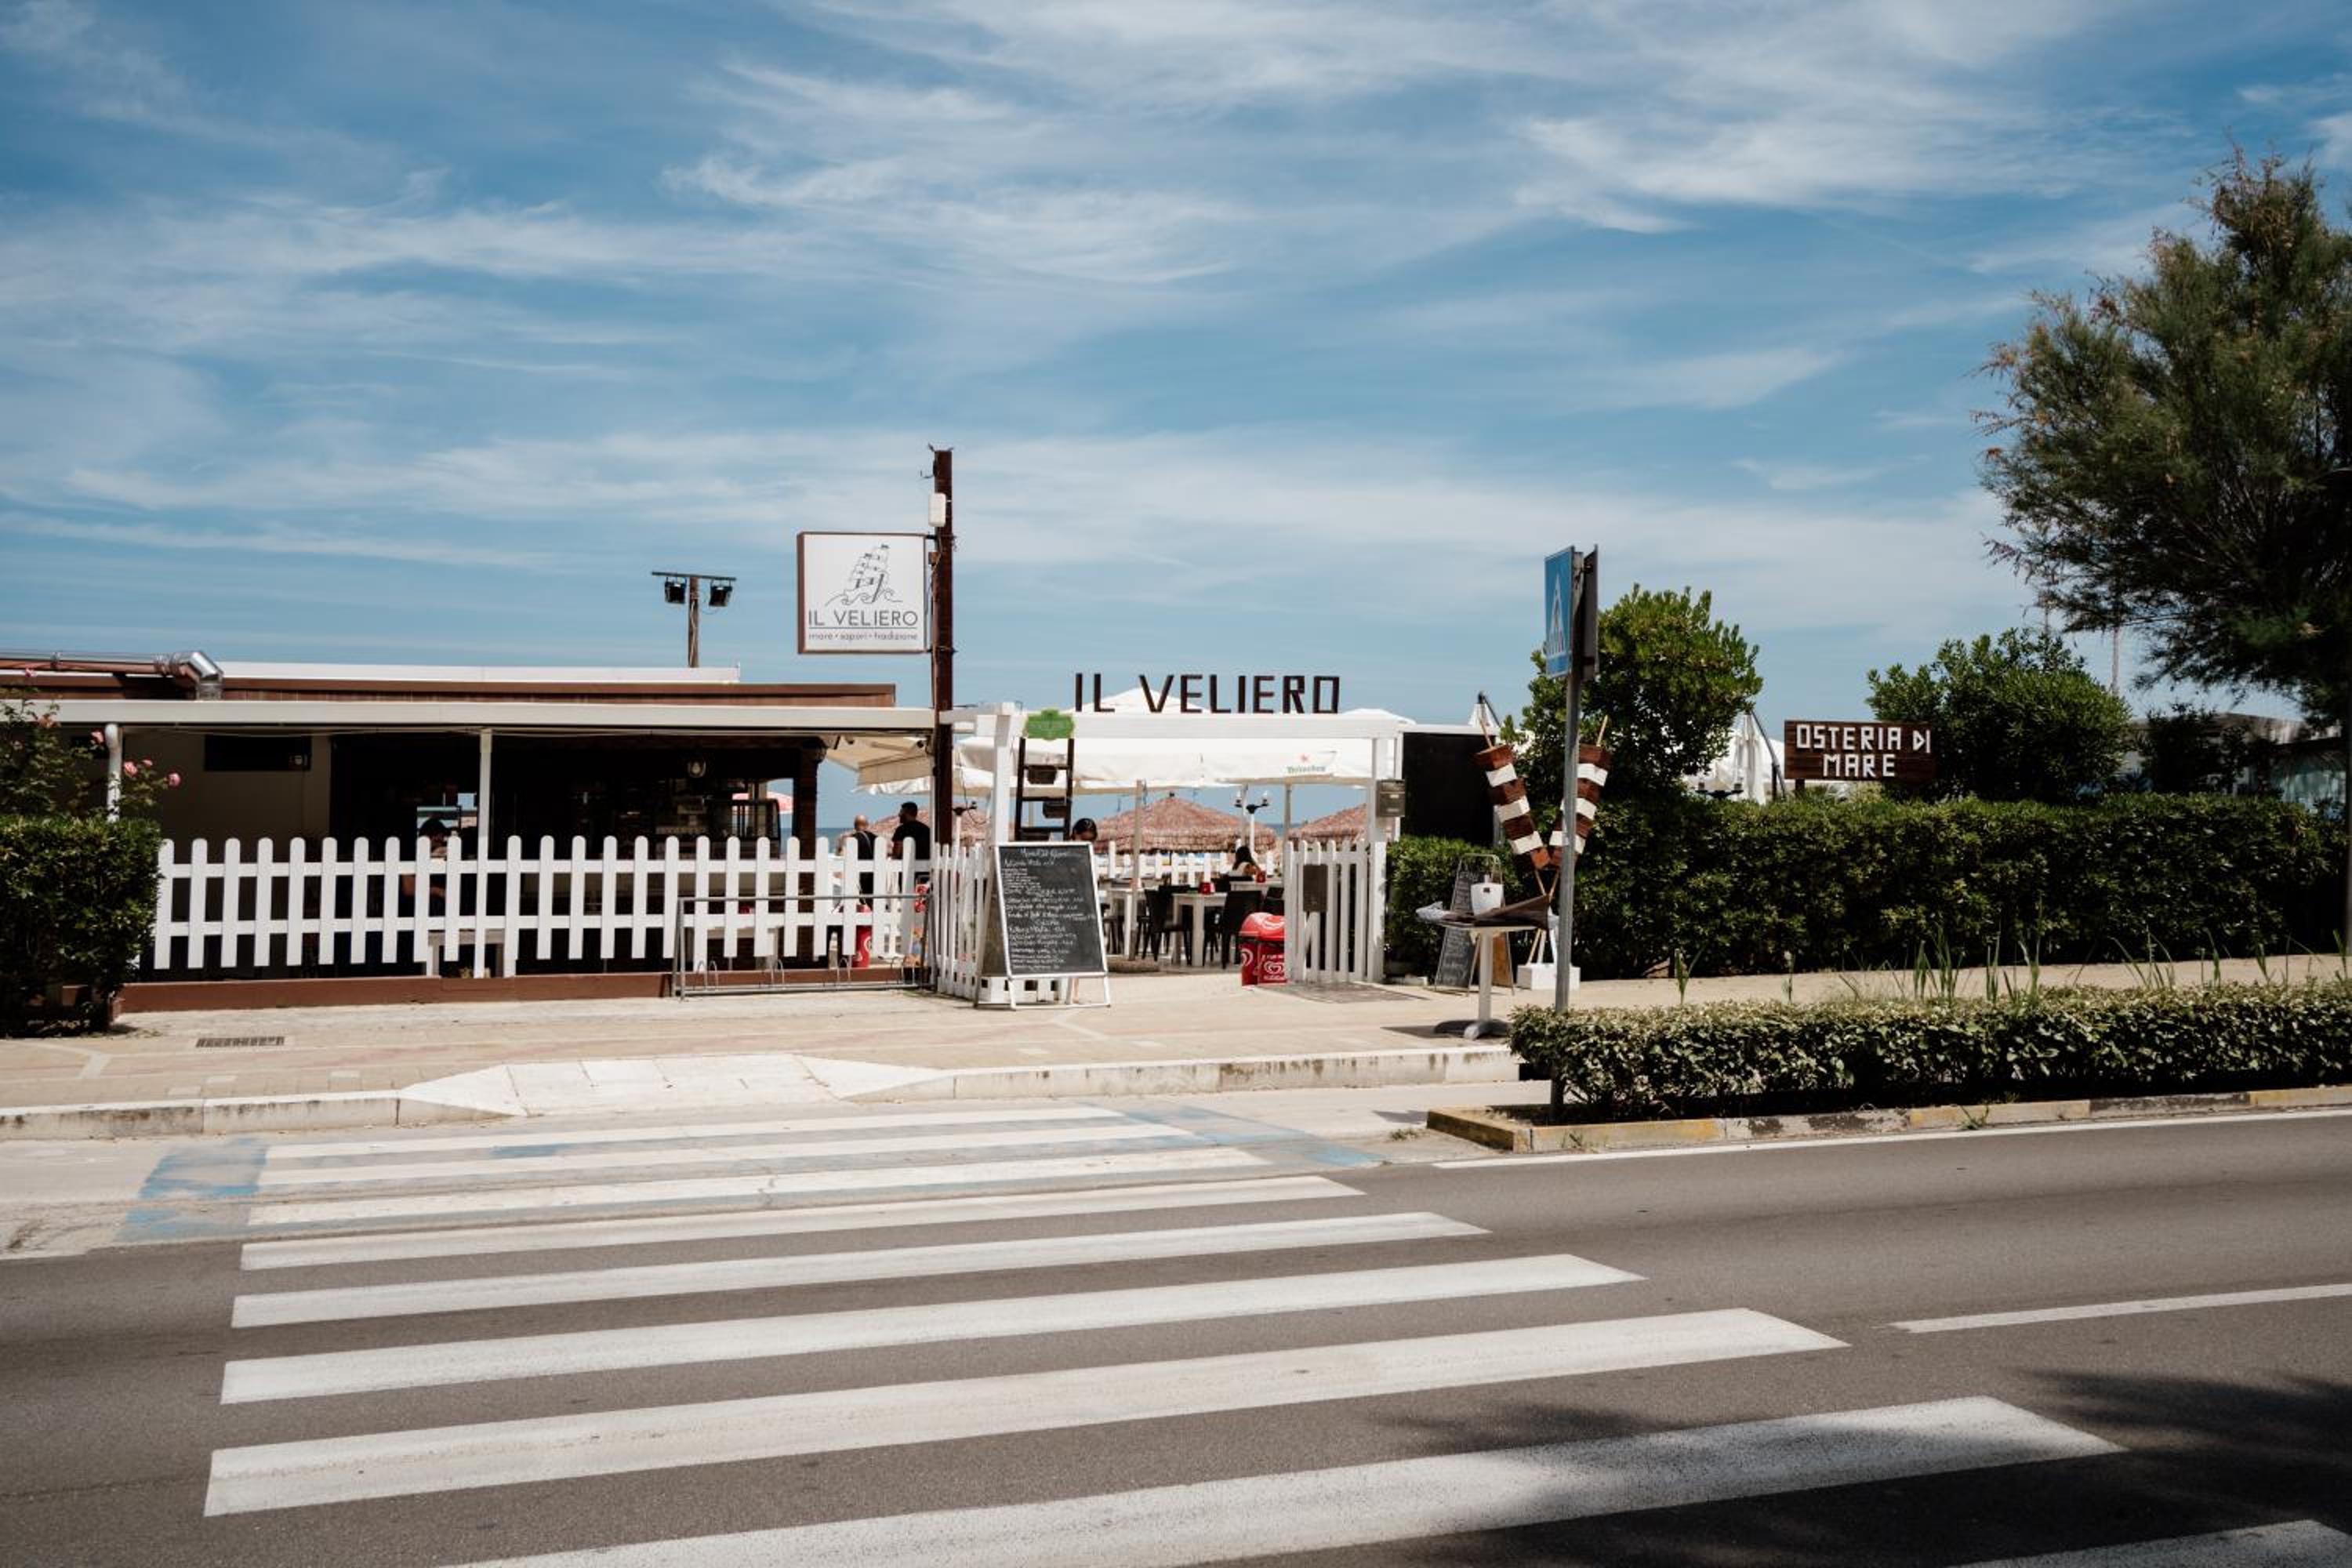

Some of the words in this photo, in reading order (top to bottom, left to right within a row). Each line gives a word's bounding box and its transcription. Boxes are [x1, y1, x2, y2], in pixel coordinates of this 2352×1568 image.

[808, 610, 825, 626] IL
[833, 610, 918, 626] VELIERO
[809, 631, 833, 640] mare
[840, 631, 869, 641] sapori
[874, 630, 918, 640] tradizione
[1075, 673, 1116, 713] IL
[1138, 674, 1340, 714] VELIERO
[1796, 724, 1901, 750] OSTERIA
[1912, 729, 1931, 753] DI
[1823, 753, 1896, 778] MARE
